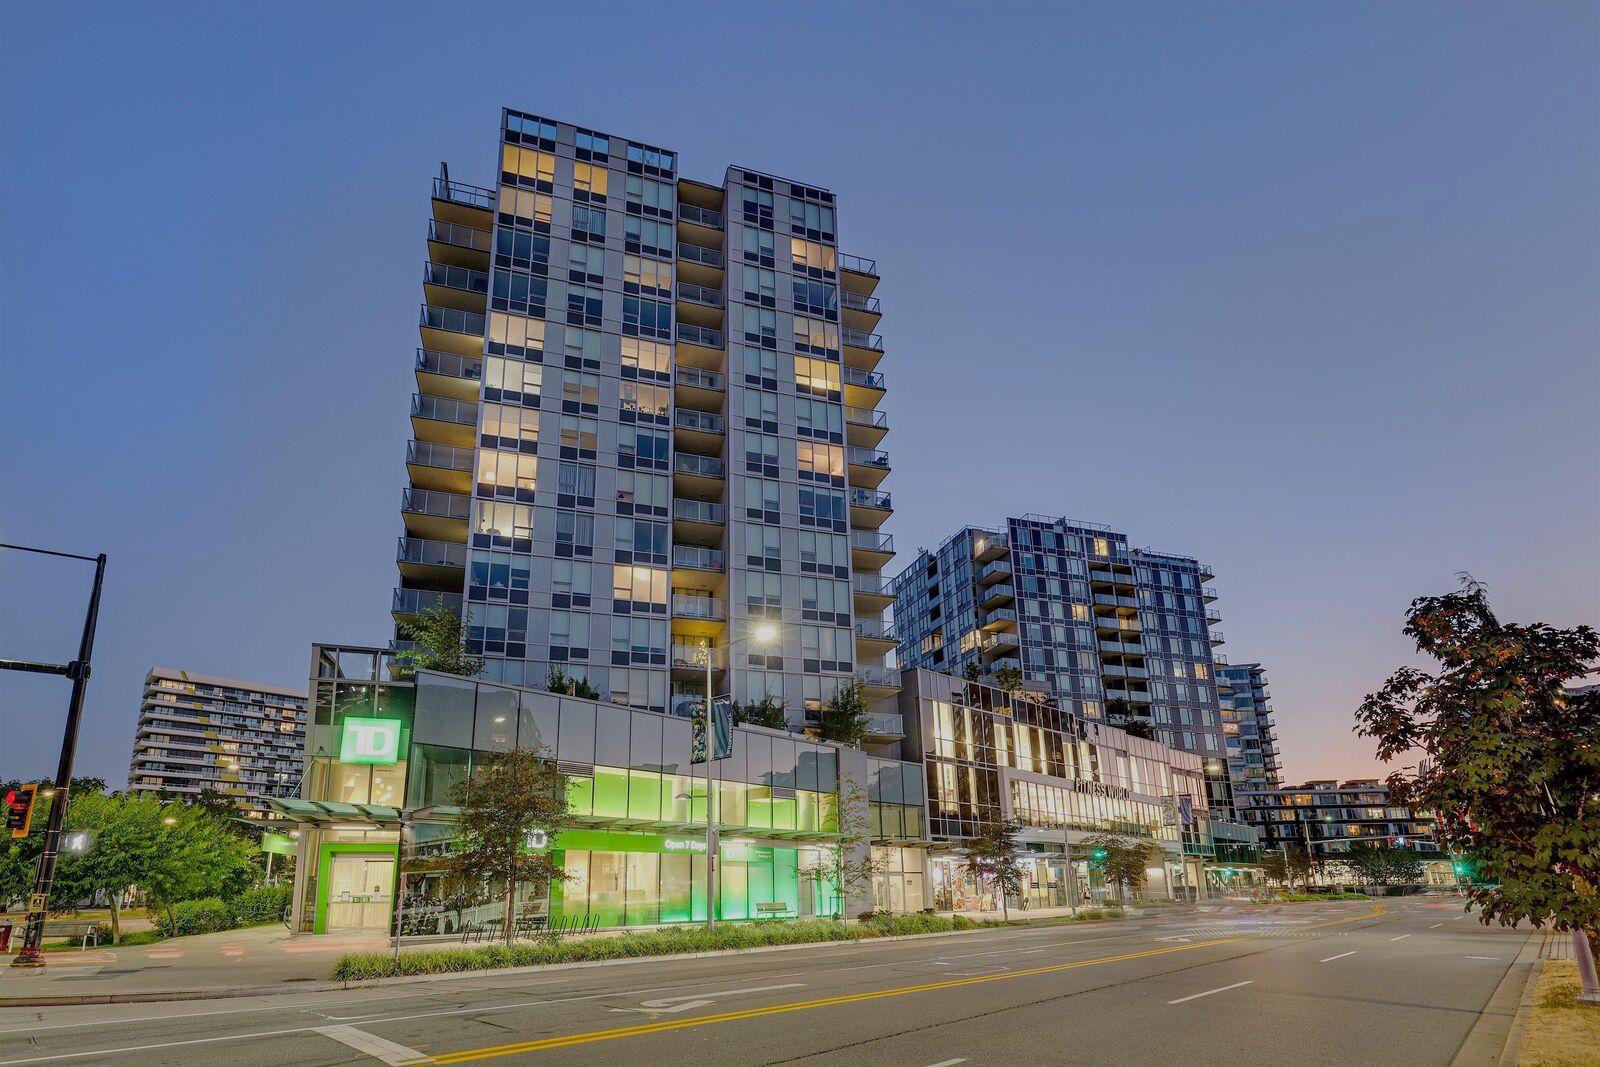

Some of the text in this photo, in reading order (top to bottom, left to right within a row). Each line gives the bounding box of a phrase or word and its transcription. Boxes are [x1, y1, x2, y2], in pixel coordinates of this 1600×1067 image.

[348, 724, 396, 756] TD
[1075, 777, 1131, 801] FITNESS WORLD
[665, 839, 684, 850] Open
[685, 840, 690, 849] 7
